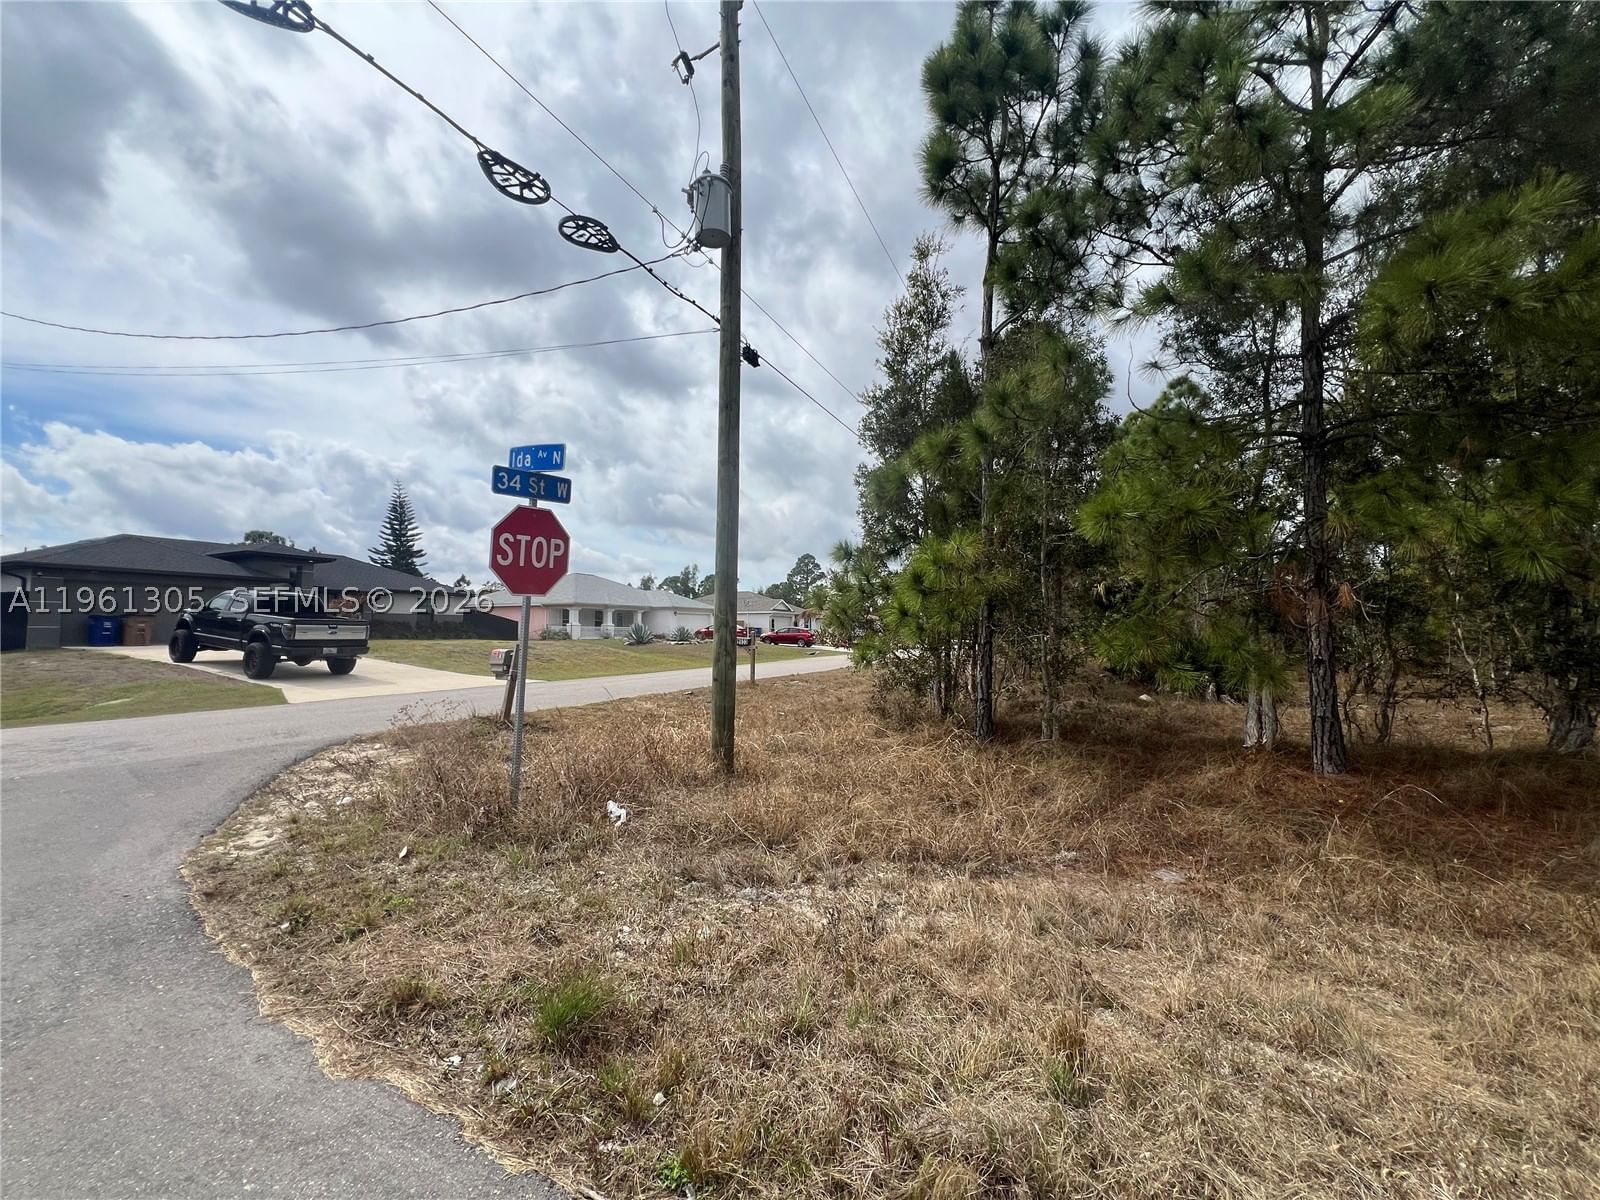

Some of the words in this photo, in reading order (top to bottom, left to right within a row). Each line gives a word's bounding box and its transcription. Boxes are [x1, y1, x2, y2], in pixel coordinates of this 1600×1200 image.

[512, 451, 531, 468] Ida
[537, 449, 548, 459] Av
[552, 450, 561, 465] N
[497, 472, 521, 492] 34
[528, 476, 545, 495] St
[557, 482, 568, 499] W
[496, 532, 565, 569] STOP
